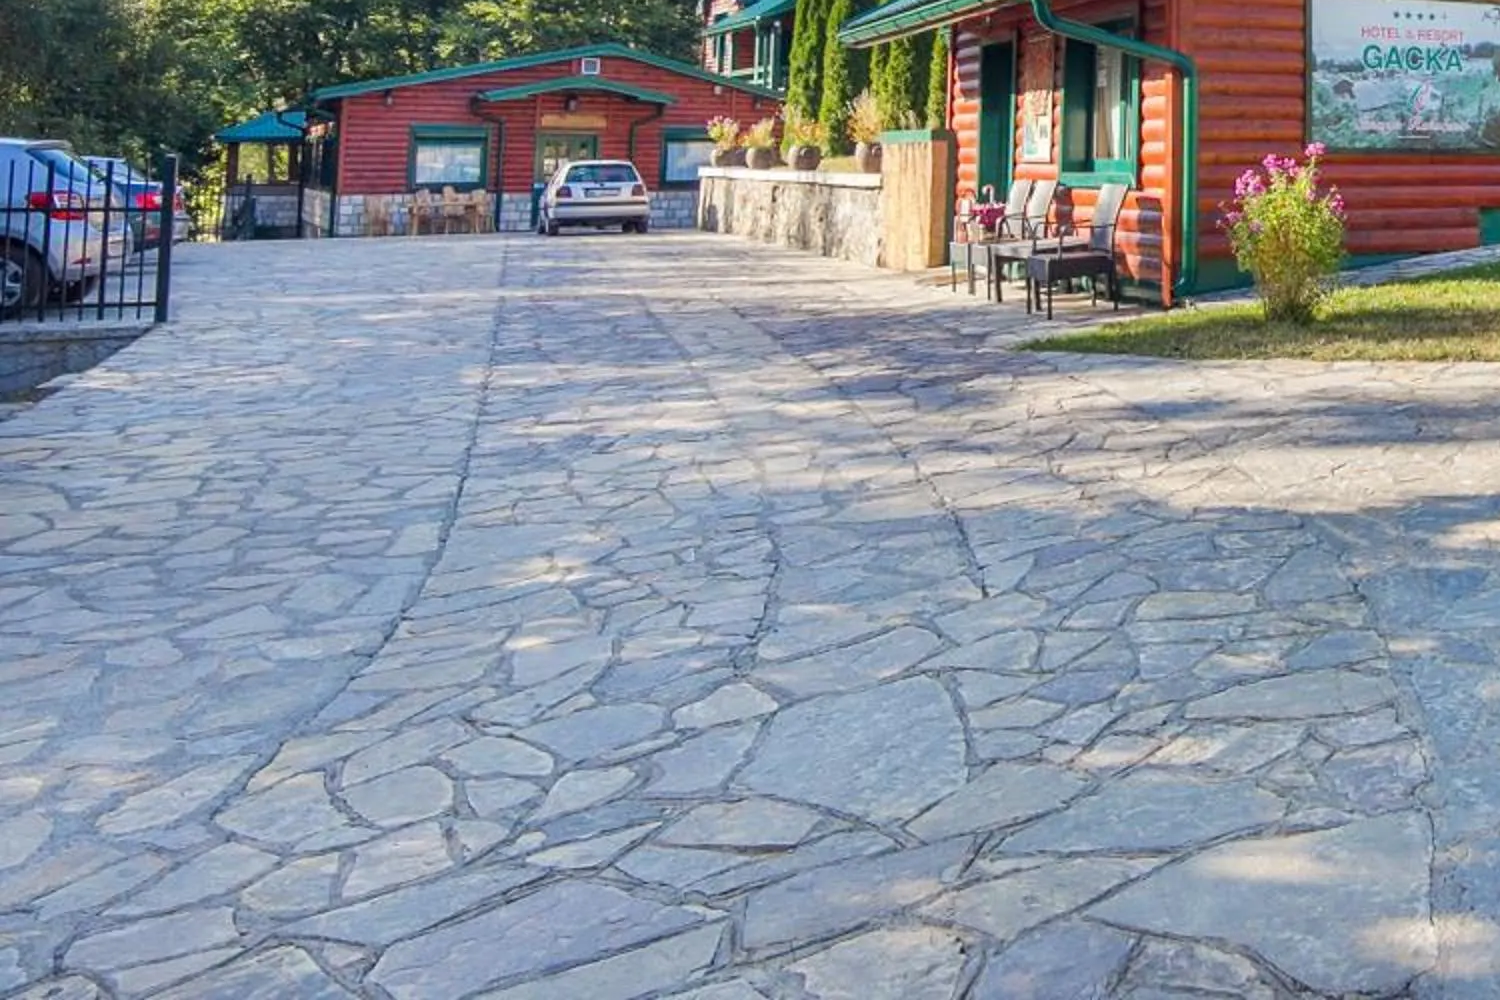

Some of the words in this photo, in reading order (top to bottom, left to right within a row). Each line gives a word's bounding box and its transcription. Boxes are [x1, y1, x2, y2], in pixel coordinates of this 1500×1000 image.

[1361, 27, 1400, 39] HOTEL
[1417, 29, 1463, 42] RESORT
[1363, 45, 1463, 72] GACKA
